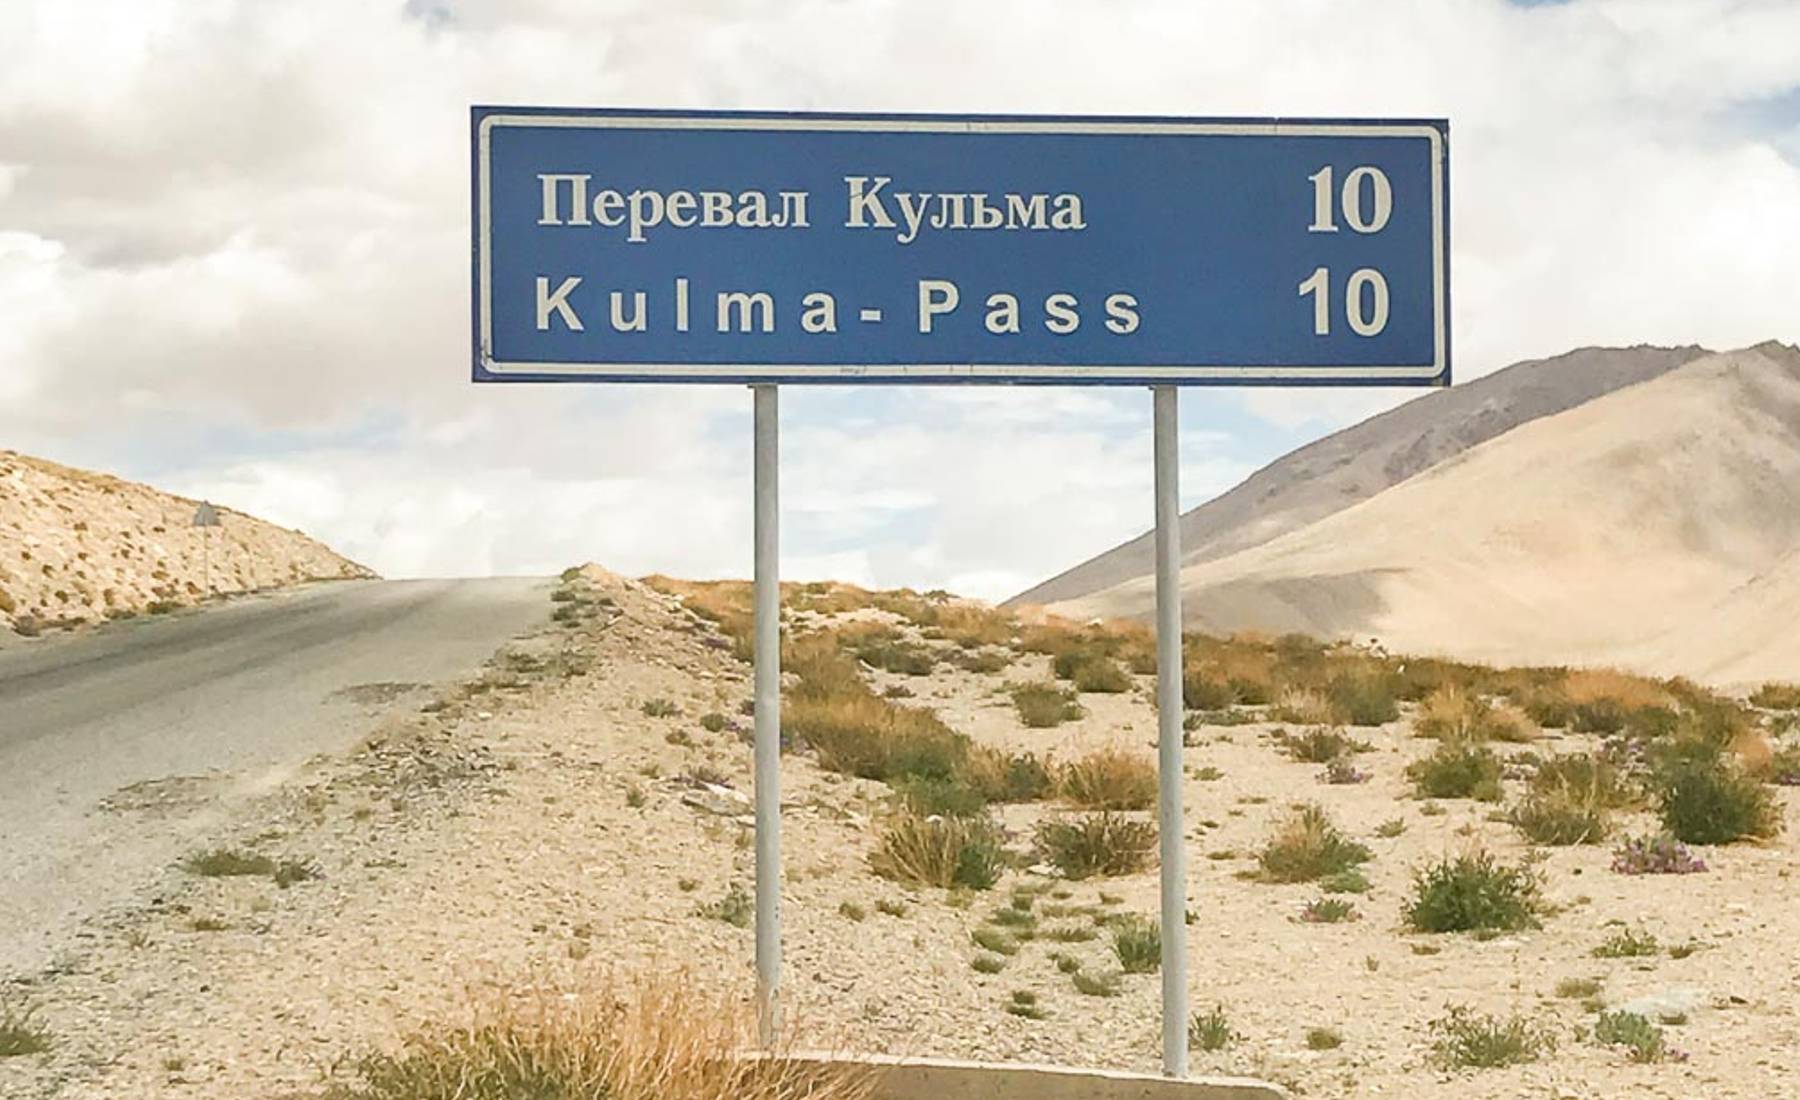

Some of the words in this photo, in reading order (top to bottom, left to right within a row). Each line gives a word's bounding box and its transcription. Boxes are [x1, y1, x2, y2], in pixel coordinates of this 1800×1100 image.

[536, 173, 811, 242] Перевал
[844, 176, 1087, 245] Кульма
[1307, 165, 1393, 234] 10
[1298, 266, 1390, 338] 10
